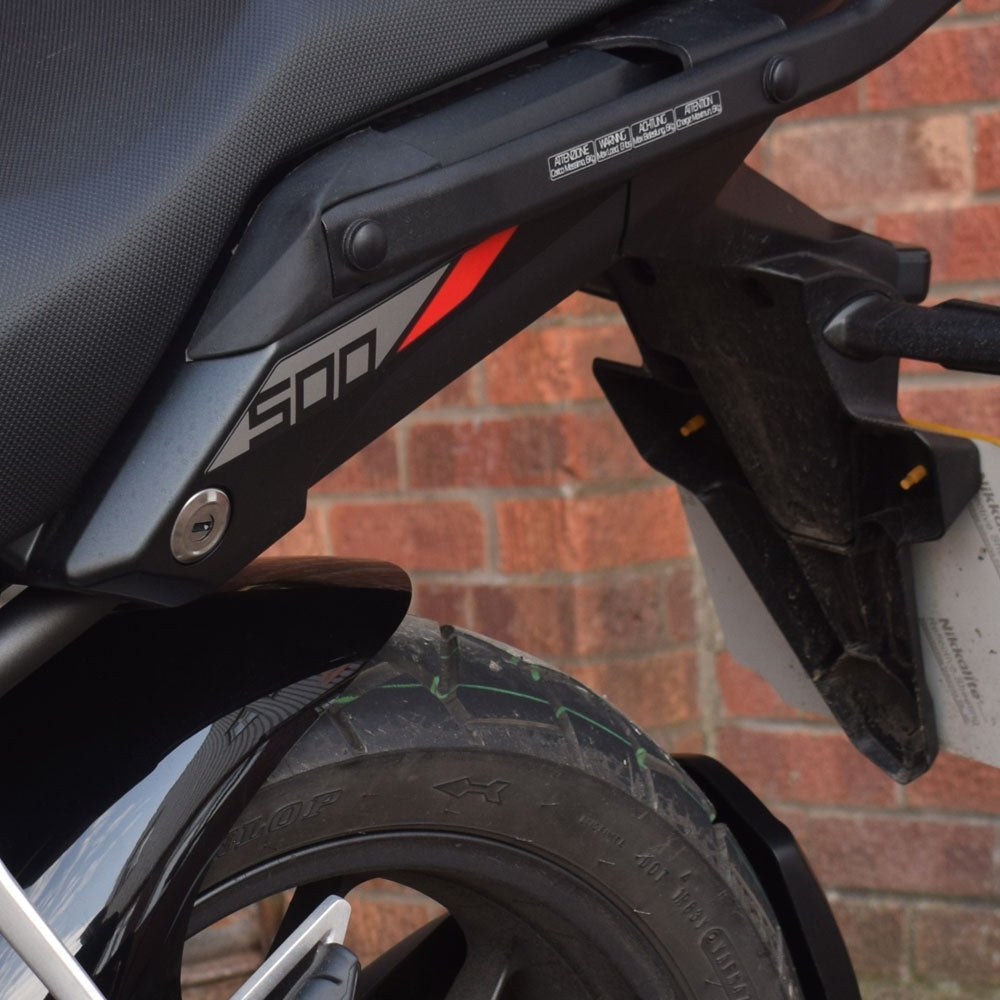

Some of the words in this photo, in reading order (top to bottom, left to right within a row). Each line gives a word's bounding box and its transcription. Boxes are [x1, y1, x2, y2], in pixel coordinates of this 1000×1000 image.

[639, 114, 667, 134] ACHTUNG
[599, 131, 627, 149] WARNING
[554, 143, 590, 167] ATTENZIONE
[248, 326, 379, 441] 500
[939, 618, 981, 700] Nikkalite
